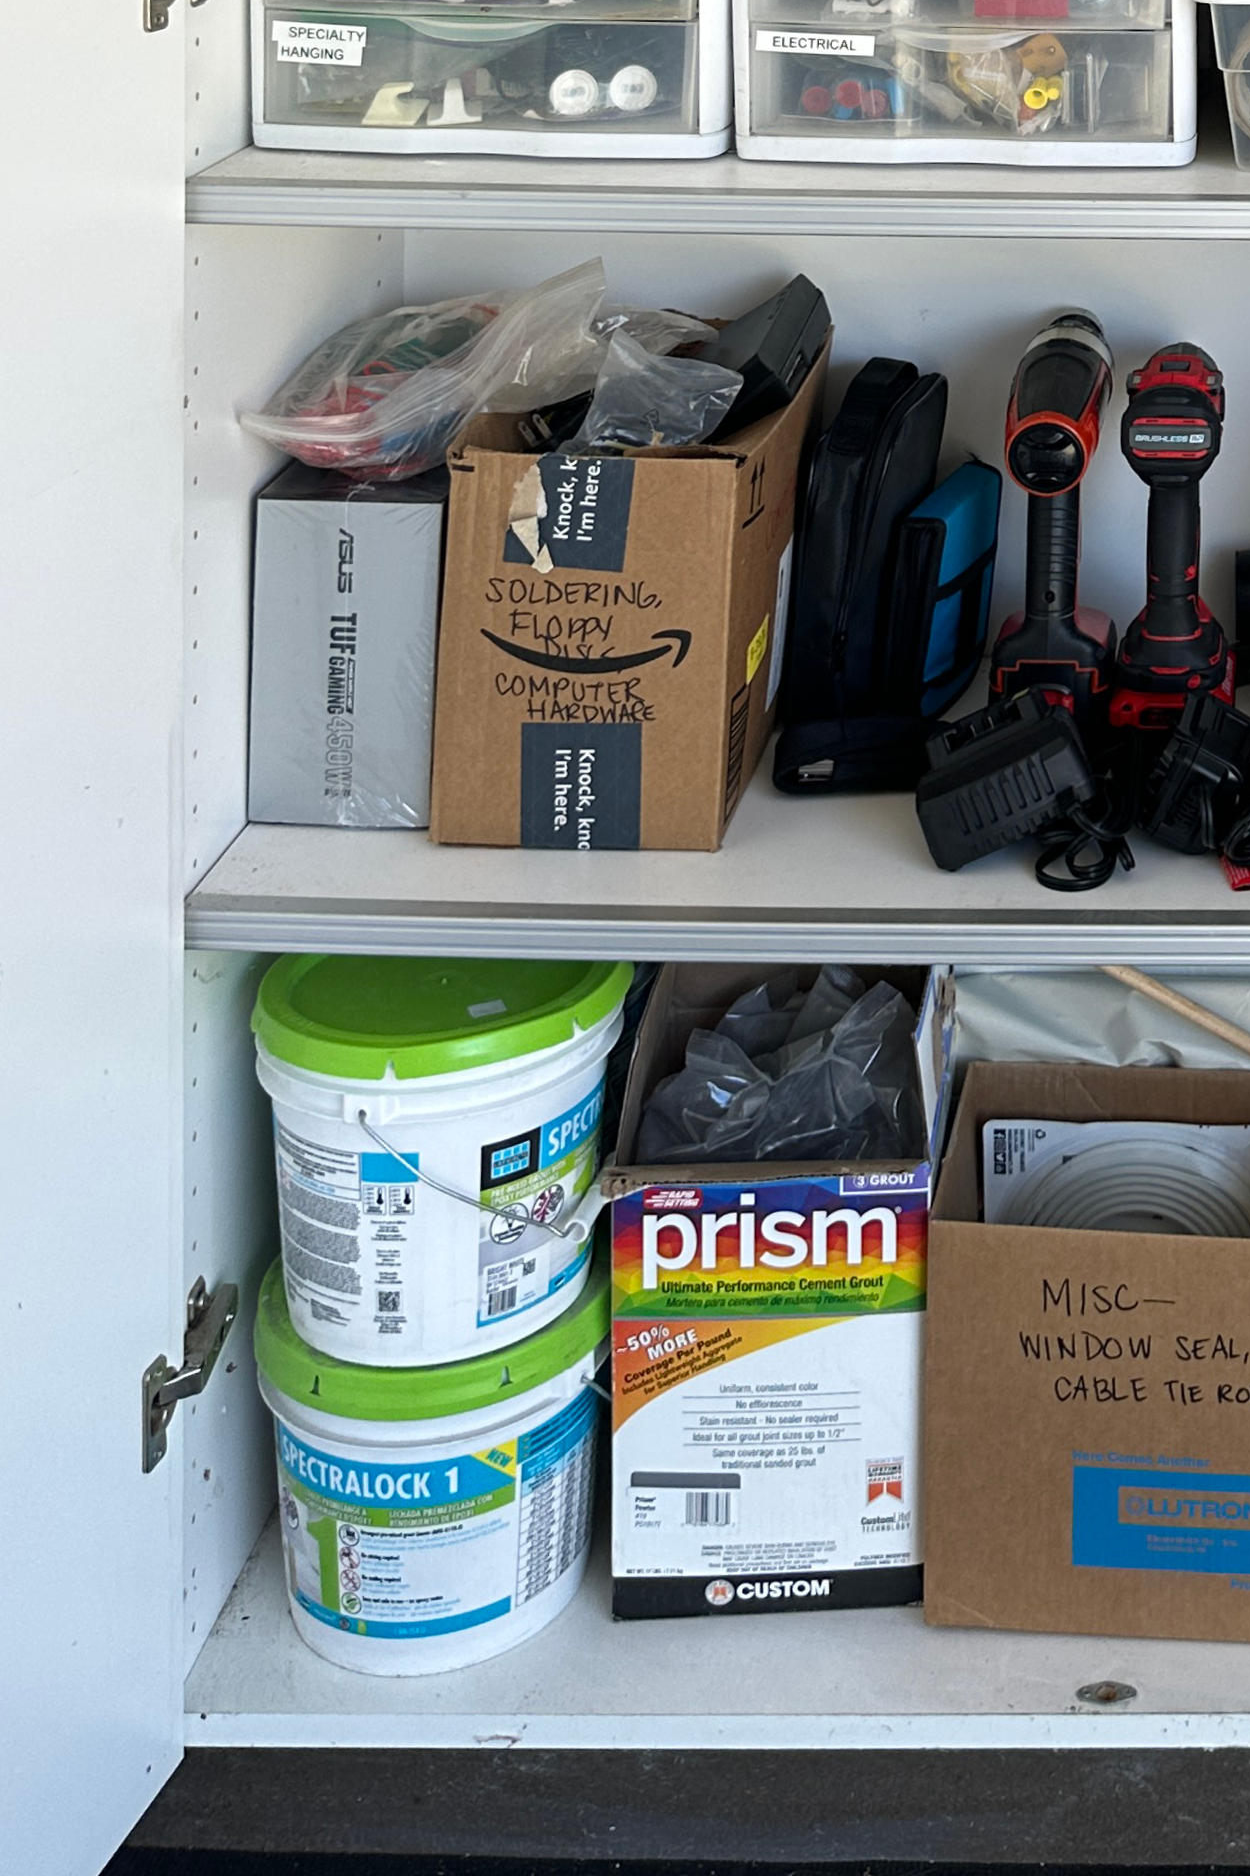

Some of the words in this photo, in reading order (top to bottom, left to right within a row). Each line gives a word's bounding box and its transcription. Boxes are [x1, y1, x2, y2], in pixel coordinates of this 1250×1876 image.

[288, 27, 365, 42] SPECIALTY
[771, 36, 858, 52] ELECTRICAL
[280, 46, 345, 61] HANGING
[580, 460, 602, 507] here.
[576, 512, 596, 541] I'm
[337, 527, 355, 594] ASUS
[485, 577, 663, 609] SOLDERING,
[329, 612, 358, 655] TUF
[509, 609, 614, 642] FLOPPY
[326, 655, 347, 716] GAMING
[495, 672, 645, 704] COMPUTER
[527, 698, 657, 723] HARDWARE
[555, 749, 572, 779] I'm
[554, 784, 573, 831] here.
[870, 1173, 915, 1186] GROUT
[643, 1193, 898, 1289] prism
[661, 1281, 714, 1293] Ultimate
[716, 1278, 796, 1293] Performance
[800, 1277, 847, 1290] Cement
[850, 1275, 884, 1288] Grout
[666, 1297, 702, 1307] Mortero
[704, 1298, 726, 1309] para
[728, 1296, 770, 1306] cemento
[770, 1295, 783, 1305] de
[823, 1292, 880, 1304] rendimiento
[624, 1356, 675, 1383] Coverage
[676, 1345, 695, 1360] Per
[697, 1328, 732, 1351] Pound
[647, 1328, 699, 1361] MORE
[1019, 1330, 1151, 1362] WINDOW
[1174, 1334, 1250, 1365] SEAL,
[719, 1384, 754, 1394] Uniform,
[755, 1382, 797, 1393] consistent
[798, 1382, 819, 1391] color
[1053, 1376, 1147, 1404] CABLE
[1164, 1379, 1202, 1405] TIE
[282, 1435, 432, 1500] SPECTRALOCK
[444, 1466, 459, 1494] 1
[484, 1447, 514, 1468] NEW
[721, 1460, 762, 1469] traditional
[764, 1459, 793, 1469] sanded
[795, 1458, 817, 1469] grout
[1071, 1449, 1104, 1462] Here
[1107, 1451, 1152, 1464] Comes
[1157, 1455, 1211, 1468] Another
[736, 1579, 831, 1600] CUSTOM
